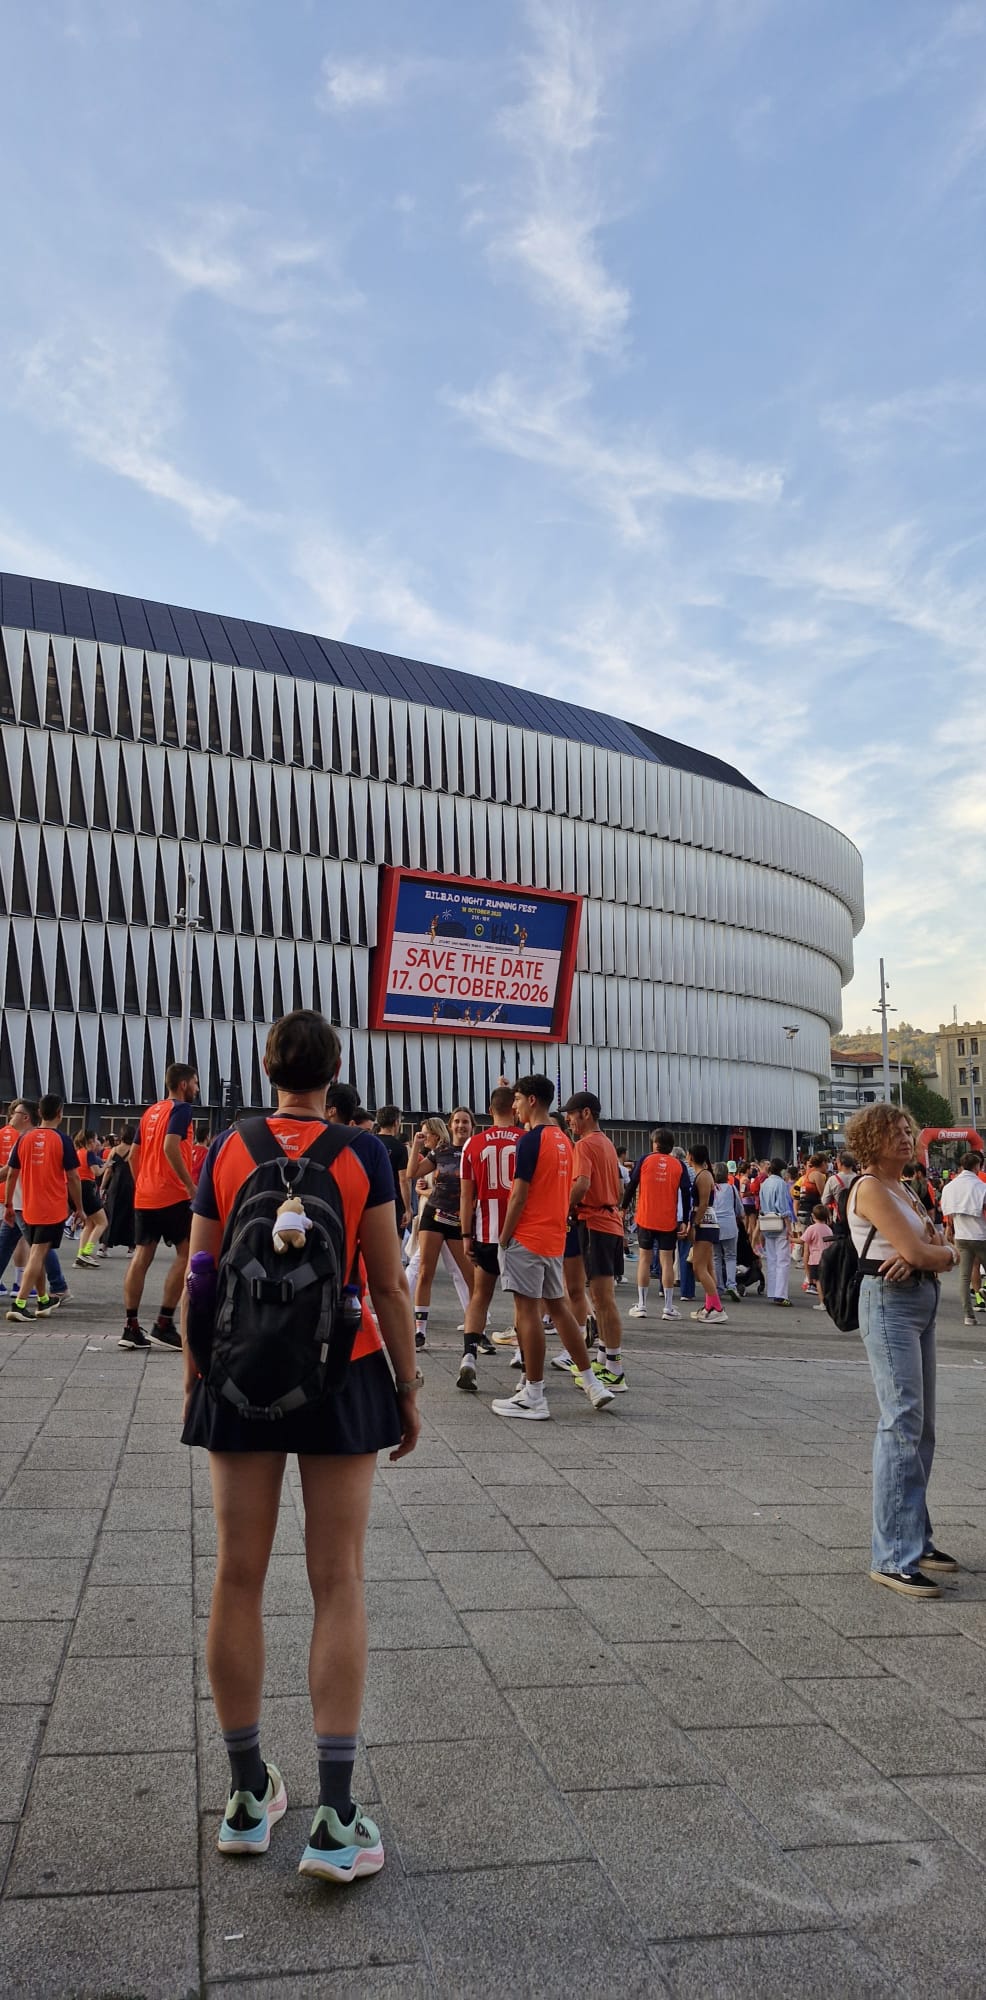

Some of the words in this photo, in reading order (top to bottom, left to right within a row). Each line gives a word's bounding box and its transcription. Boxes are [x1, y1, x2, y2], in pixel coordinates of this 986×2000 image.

[425, 890, 460, 902] BILBAO
[461, 897, 484, 906] NIGHT
[485, 899, 517, 911] RUNNING
[518, 904, 538, 914] FEST
[405, 947, 456, 971] SAVE
[461, 953, 497, 976] THE
[501, 958, 544, 981] DATE
[392, 970, 412, 991] 17.
[419, 973, 549, 1003] OCTOBER.2026
[485, 1130, 520, 1142] ALTUBE
[480, 1145, 517, 1190] 10
